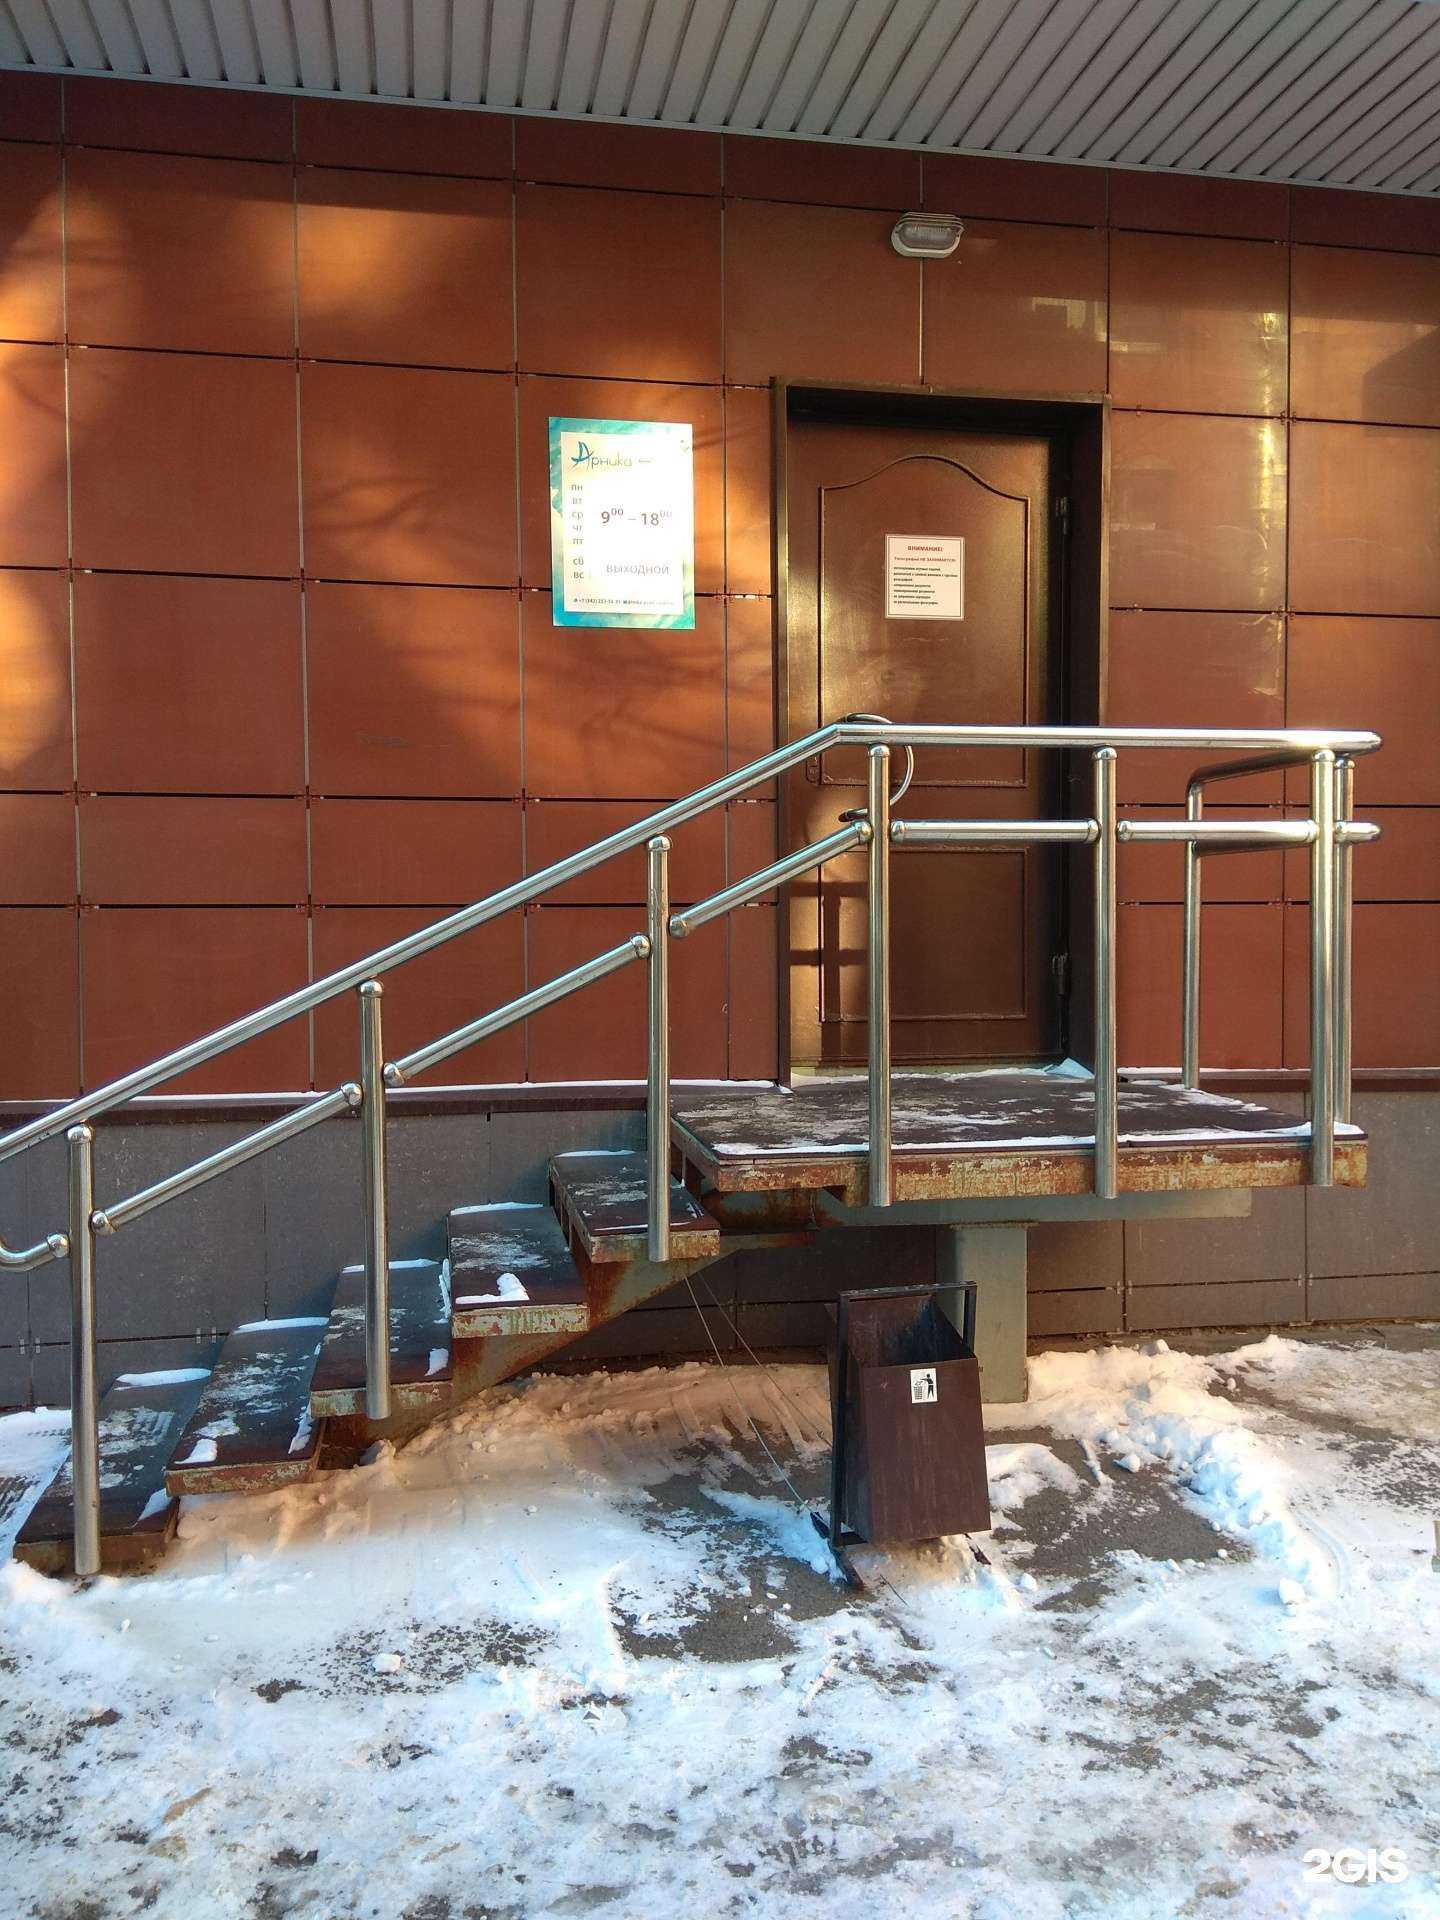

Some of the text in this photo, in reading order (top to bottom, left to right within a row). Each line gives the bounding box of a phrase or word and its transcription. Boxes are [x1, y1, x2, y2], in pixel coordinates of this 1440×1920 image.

[571, 441, 632, 470] Арника
[571, 511, 584, 520] ср
[573, 571, 584, 579] вс
[606, 563, 670, 576] выходной
